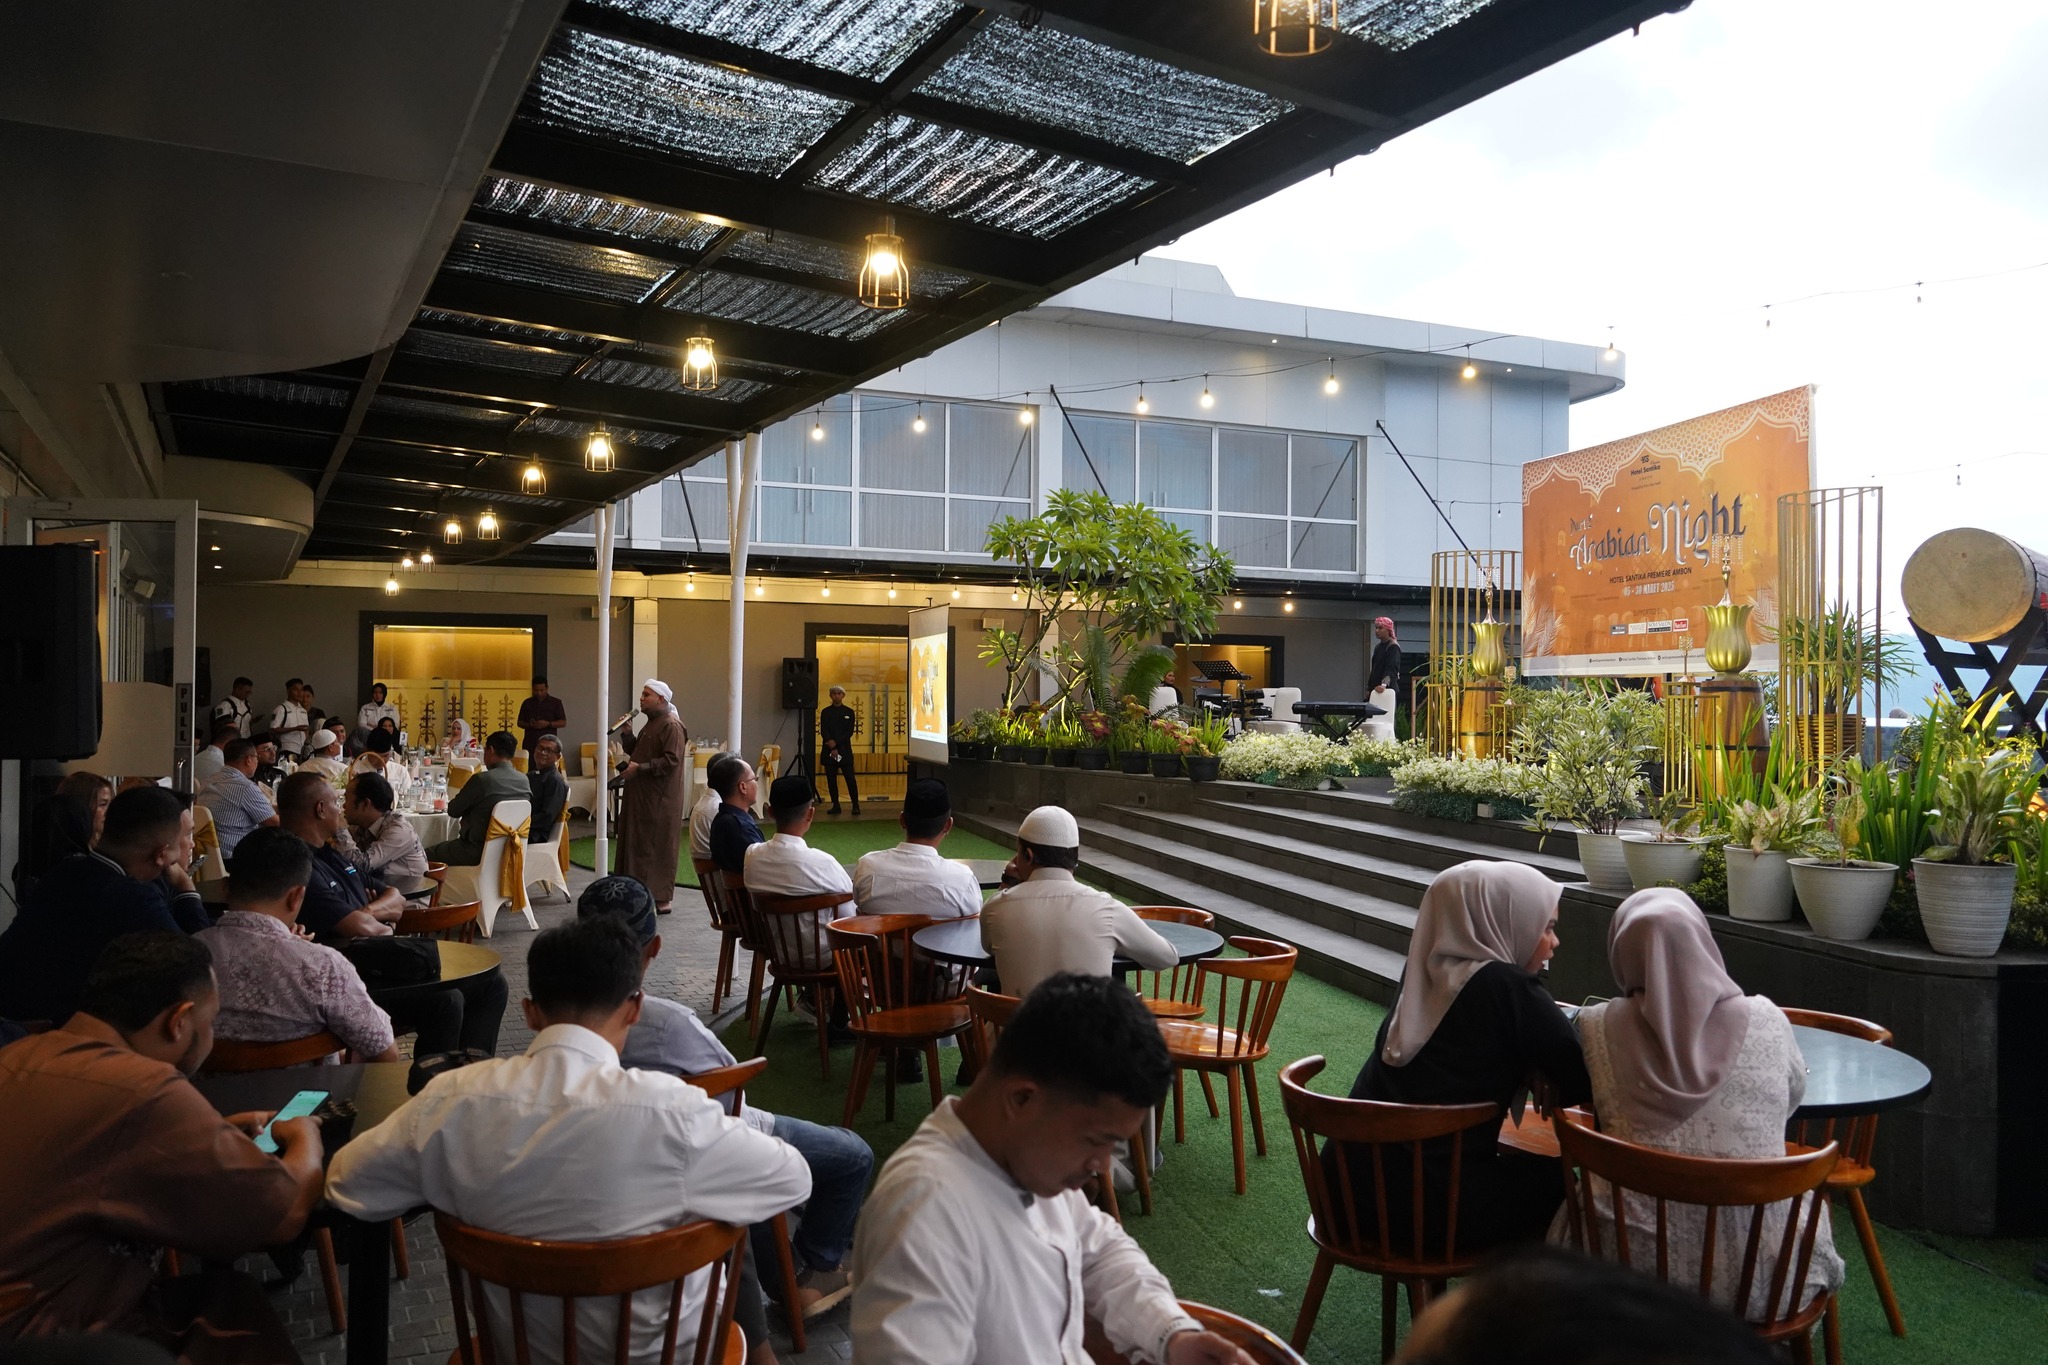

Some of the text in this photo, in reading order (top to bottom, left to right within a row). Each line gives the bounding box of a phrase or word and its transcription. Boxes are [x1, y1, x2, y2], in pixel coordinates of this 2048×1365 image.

[1631, 468, 1643, 476] Hotel
[1569, 492, 1747, 570] Arabian Night
[1609, 567, 1692, 584] HOTEL SANTIKA PREMIERE AMBON
[1643, 582, 1660, 595] MARET
[180, 688, 188, 742] PULL
